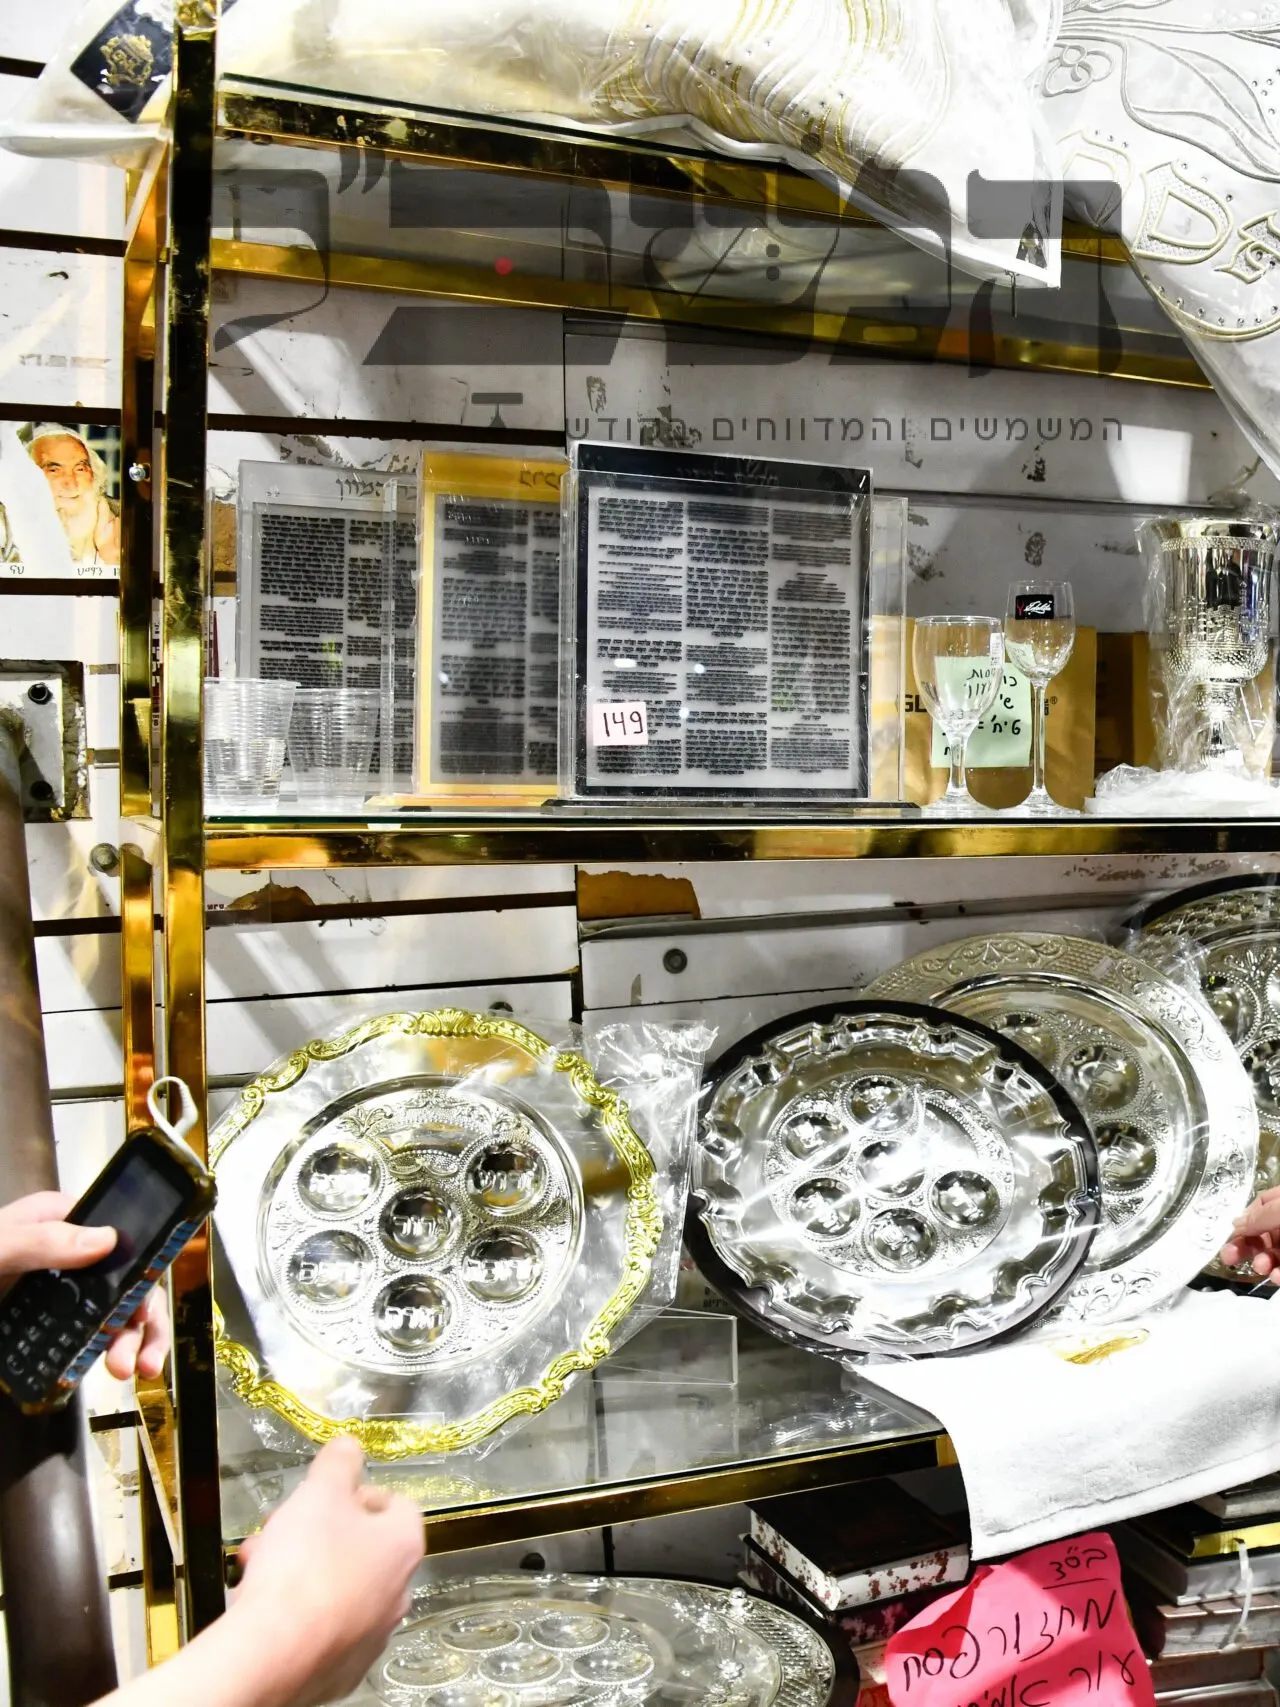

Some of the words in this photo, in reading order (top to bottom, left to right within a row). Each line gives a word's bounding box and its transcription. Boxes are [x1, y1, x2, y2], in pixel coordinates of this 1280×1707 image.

[602, 710, 644, 738] 149
[902, 1625, 981, 1693] פסח
[987, 1589, 1117, 1663] מחזור
